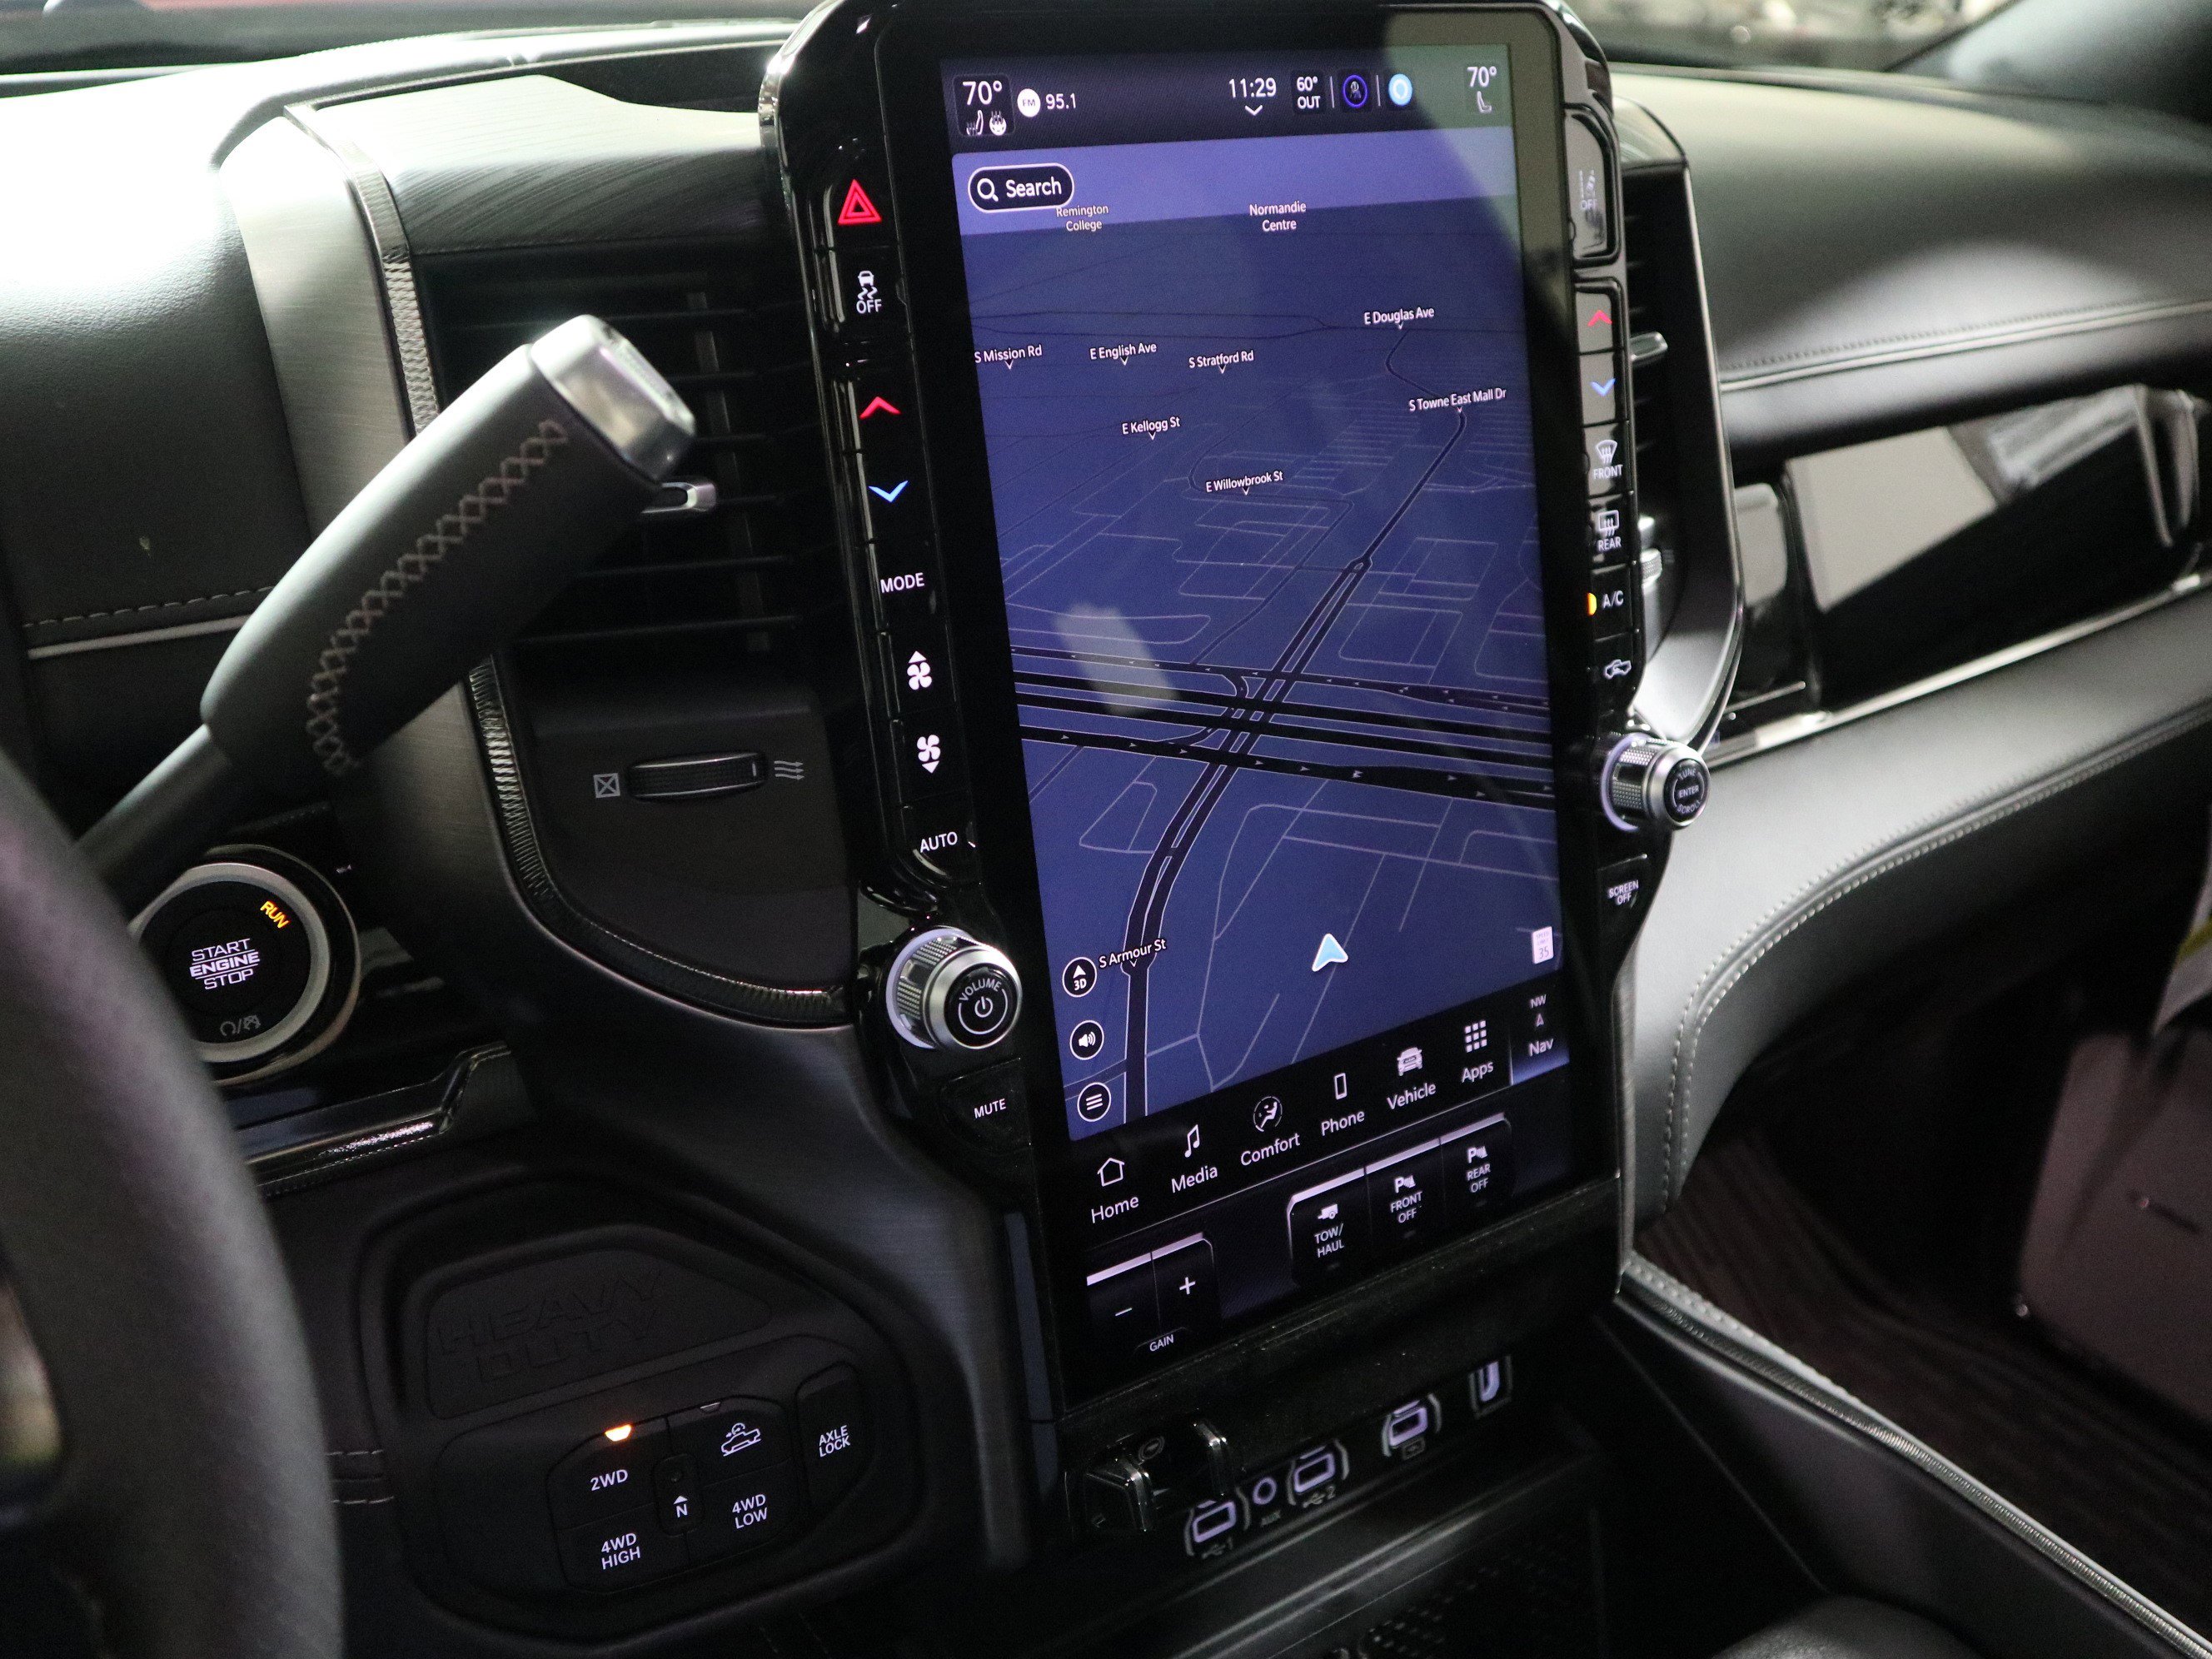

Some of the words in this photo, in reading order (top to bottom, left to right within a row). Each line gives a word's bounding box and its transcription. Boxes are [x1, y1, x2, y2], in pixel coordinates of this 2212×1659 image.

[1228, 77, 1277, 98] 11:29
[1044, 92, 1077, 110] 95.1
[1297, 95, 1321, 110] OUT
[1005, 177, 1063, 199] Search
[1055, 203, 1109, 220] Remington
[1248, 200, 1307, 217] Normandie
[1065, 220, 1103, 233] College
[1262, 218, 1298, 233] Centre
[856, 299, 883, 315] OFF
[1363, 312, 1371, 325] E
[1373, 309, 1415, 325] Douglas
[1416, 306, 1436, 319] Ave
[974, 351, 983, 364] S
[983, 347, 1026, 363] Mission
[1027, 344, 1043, 358] Rd
[1089, 348, 1097, 360] E
[1098, 344, 1135, 361] English
[1136, 342, 1158, 356] Ave
[1188, 356, 1196, 369] S
[1196, 351, 1240, 368] Stratford
[1240, 349, 1255, 362] Rd
[1408, 400, 1417, 411] S
[1417, 396, 1451, 411] Towne
[1450, 393, 1472, 406] East
[1472, 389, 1495, 402] Mall
[1495, 387, 1507, 400] Dr
[1122, 422, 1129, 435] E
[1130, 419, 1168, 436] Kellogg
[1169, 416, 1181, 428] St
[1206, 481, 1213, 493] E
[1213, 473, 1272, 491] Willowbrook
[1273, 471, 1283, 483] St
[1592, 464, 1624, 480] FRONT
[1597, 536, 1622, 552] REAR
[879, 572, 925, 594] MODE
[1602, 590, 1624, 609] A/C
[1677, 785, 1700, 799] ENTER
[919, 831, 959, 854] AUTO
[1607, 879, 1639, 899] SCREEN
[1616, 892, 1632, 906] OFF
[260, 899, 290, 929] RUN
[191, 938, 251, 962] START
[1099, 956, 1108, 969] S
[1108, 944, 1153, 966] Armour
[1154, 937, 1167, 953] St
[1538, 945, 1550, 959] 35
[188, 951, 262, 978] ENGINE
[203, 969, 254, 990] STOP
[1074, 978, 1088, 991] 3D
[959, 978, 1002, 1002] VOLUME
[1530, 994, 1547, 1009] NW
[1528, 1039, 1554, 1057] Nav
[1462, 1060, 1494, 1084] Apps
[1387, 1082, 1437, 1110] Vehicle
[974, 1098, 1007, 1118] MUTE
[1321, 1110, 1366, 1136] Phone
[1240, 1133, 1301, 1167] Comfort
[1171, 1165, 1218, 1193] Media
[1467, 1163, 1491, 1181] REAR
[1470, 1178, 1489, 1193] OFF
[1091, 1196, 1139, 1223] Home
[1390, 1191, 1423, 1213] FRONT
[1397, 1208, 1417, 1223] OFF
[1314, 1223, 1344, 1244] TOW/
[1317, 1240, 1345, 1258] HAUL
[436, 1271, 664, 1356] HEAVY
[476, 1308, 661, 1384] DUTY
[1149, 1334, 1174, 1352] GAIN
[819, 1425, 849, 1447] AXLE
[819, 1436, 850, 1457] LOCK
[590, 1468, 629, 1492] 2WD
[676, 1504, 688, 1517] N
[731, 1493, 766, 1514] 4WD
[735, 1507, 768, 1529] LOW
[600, 1532, 637, 1554] 4WD
[601, 1546, 641, 1570] HIGH
